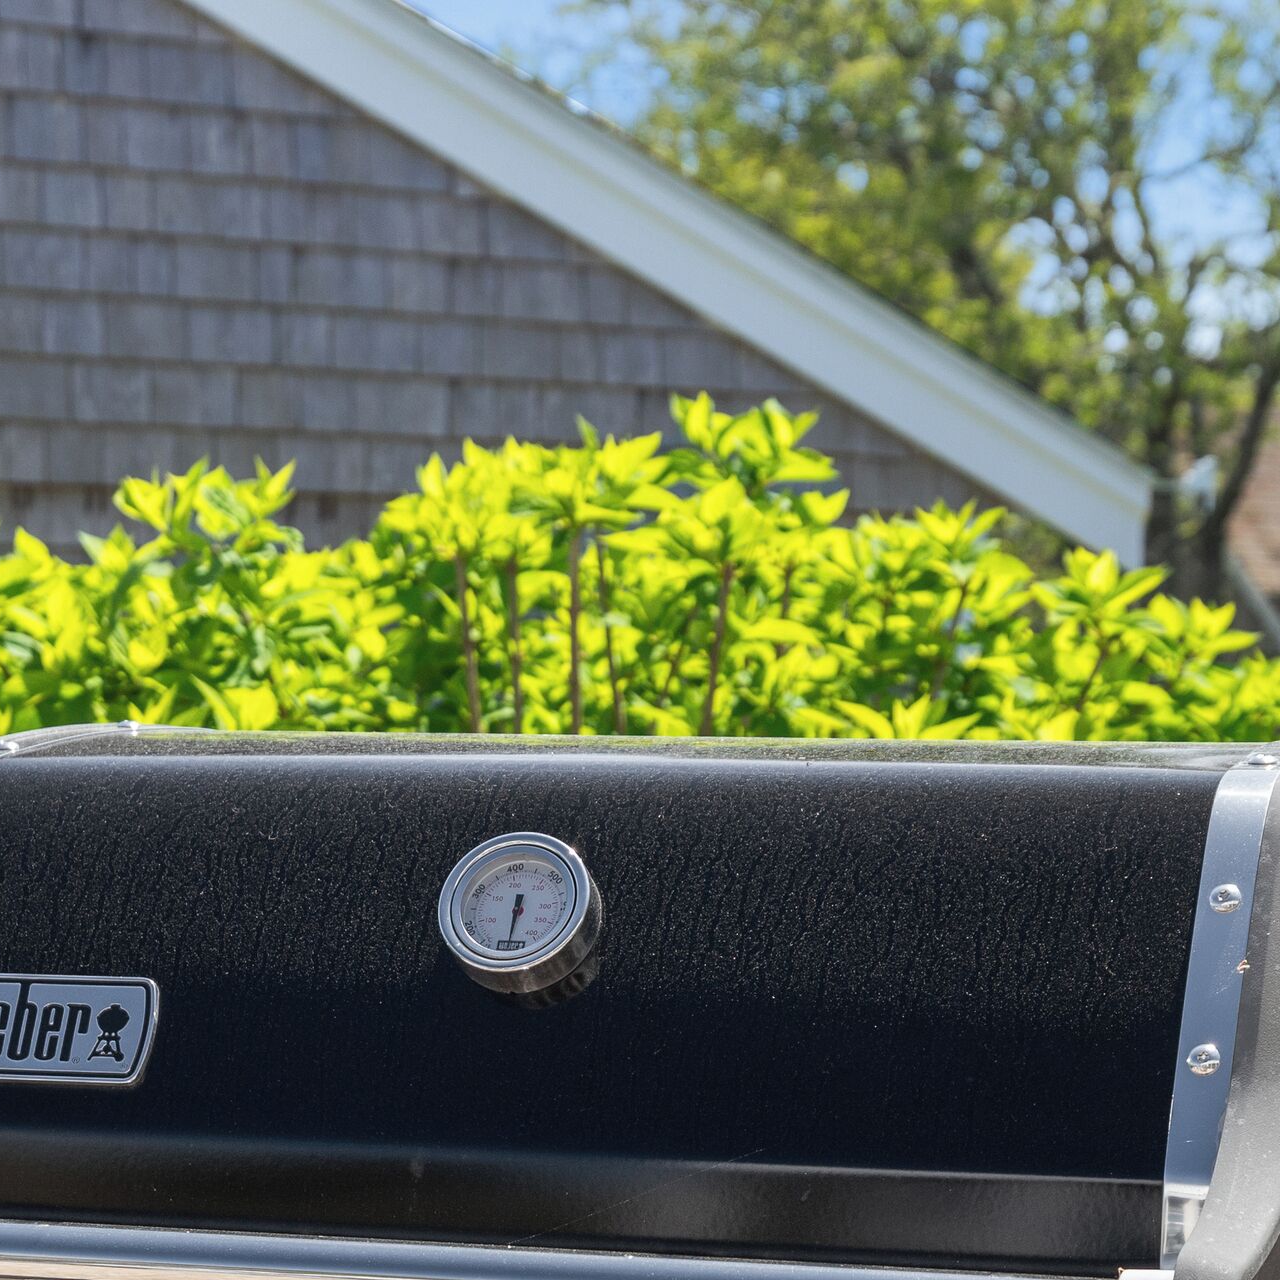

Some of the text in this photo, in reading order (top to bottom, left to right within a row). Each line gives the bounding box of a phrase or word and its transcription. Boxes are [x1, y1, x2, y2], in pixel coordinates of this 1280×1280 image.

[507, 863, 524, 873] 400
[548, 870, 563, 884] 500
[472, 884, 486, 899] 300
[465, 920, 476, 936] 200
